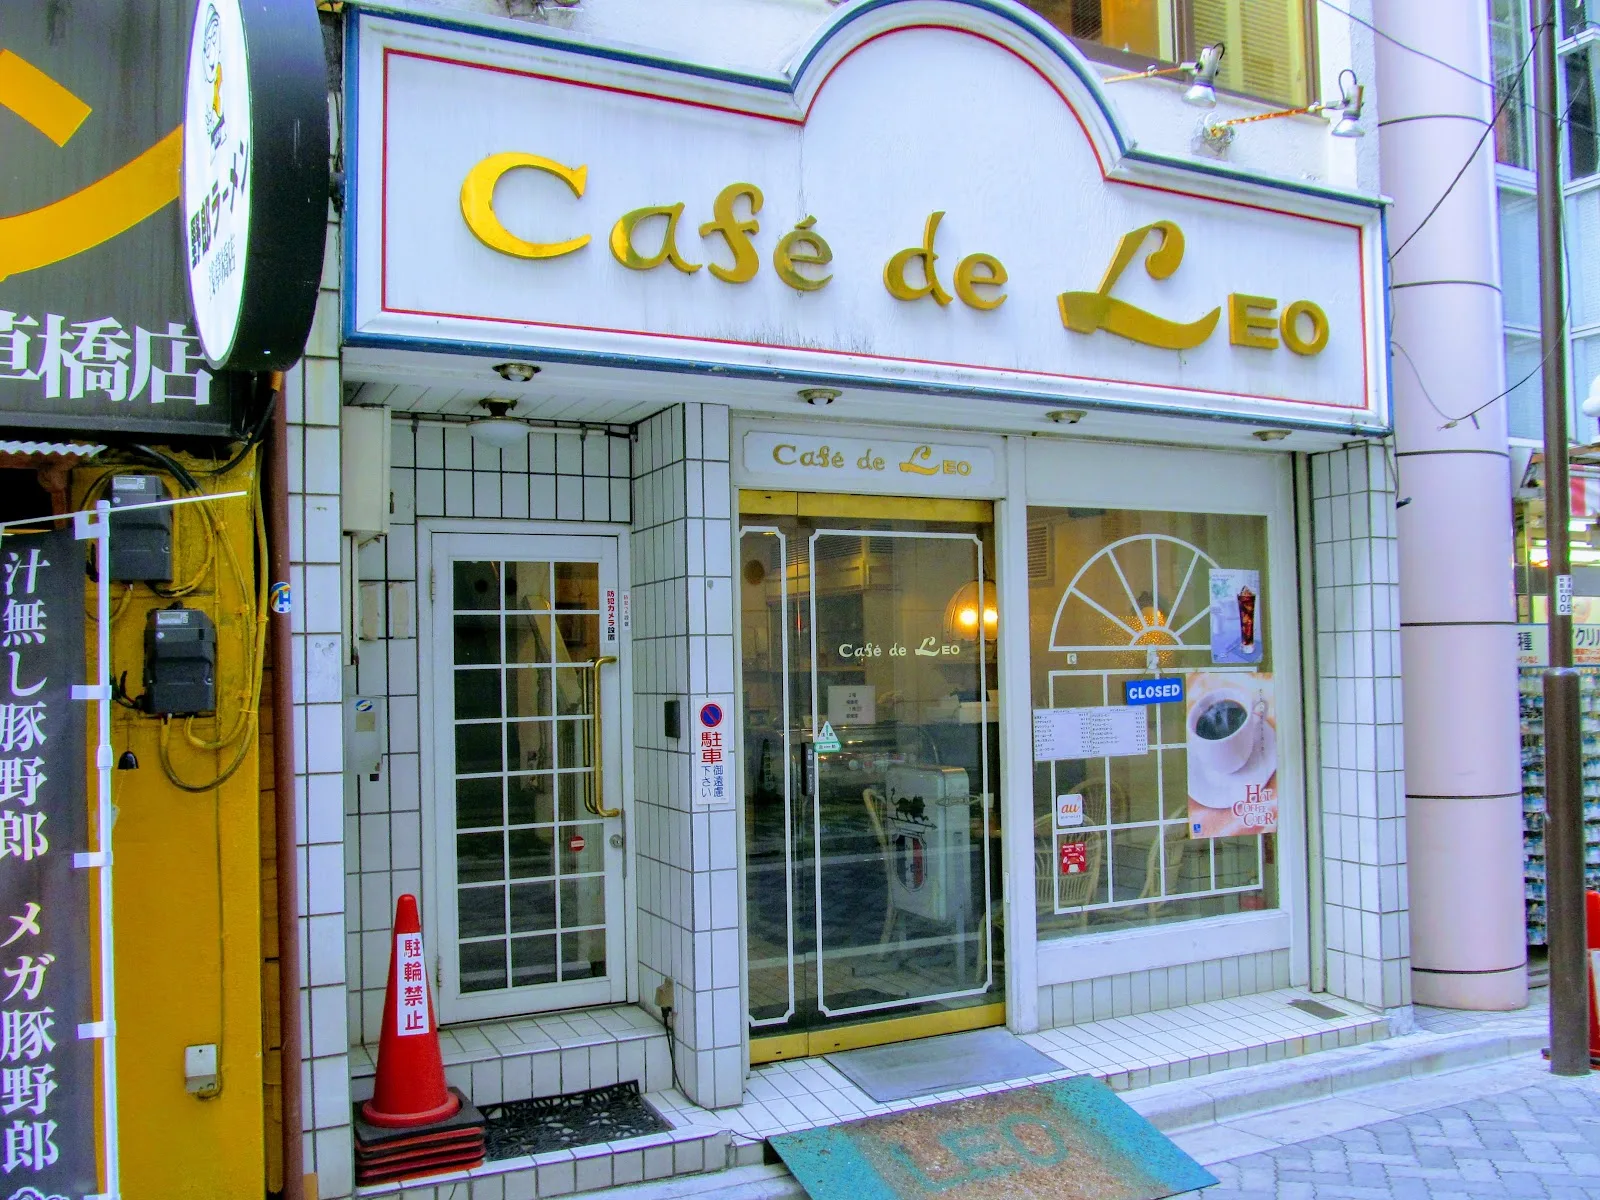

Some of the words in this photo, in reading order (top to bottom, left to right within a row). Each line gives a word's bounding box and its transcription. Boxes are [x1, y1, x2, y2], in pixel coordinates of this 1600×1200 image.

[459, 151, 833, 291] Café
[883, 210, 1008, 310] de
[772, 443, 845, 468] Café
[856, 448, 886, 471] de
[607, 590, 616, 641] 防犯カメラ設置
[838, 642, 882, 658] Café
[889, 642, 907, 657] de
[0, 548, 50, 861] 汁無し豚野郎
[1129, 684, 1180, 700] CLOSED
[701, 731, 723, 764] 駐車
[701, 765, 712, 798] 下さい
[713, 764, 725, 798] 御遠慮
[403, 938, 424, 1031] 駐輪禁止
[0, 902, 60, 1174] メガ豚野郎
